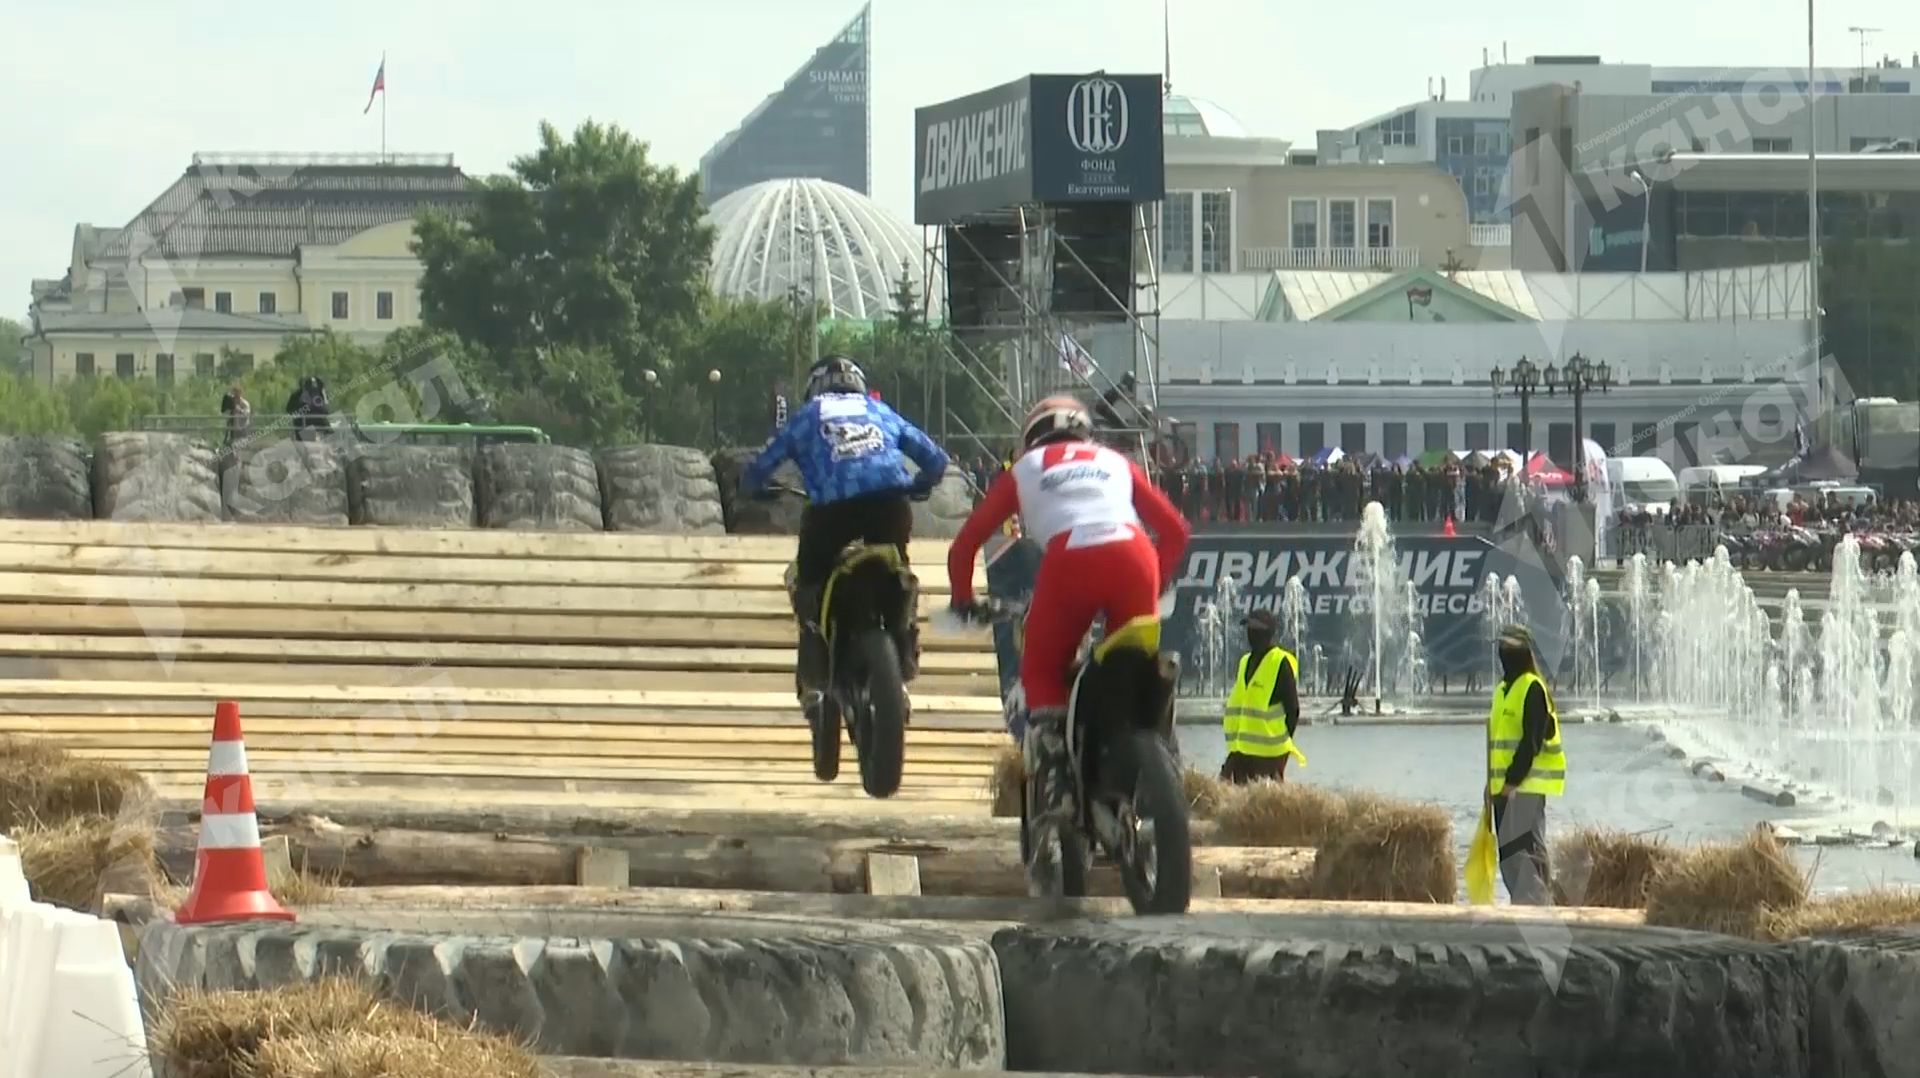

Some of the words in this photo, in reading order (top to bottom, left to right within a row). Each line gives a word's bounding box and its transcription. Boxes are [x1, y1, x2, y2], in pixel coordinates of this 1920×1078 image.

[809, 70, 865, 83] SUMMIT
[920, 98, 1029, 195] ДВИЖЕНИЕ
[1081, 159, 1116, 172] ФОНД
[1067, 183, 1131, 197] Екатерины
